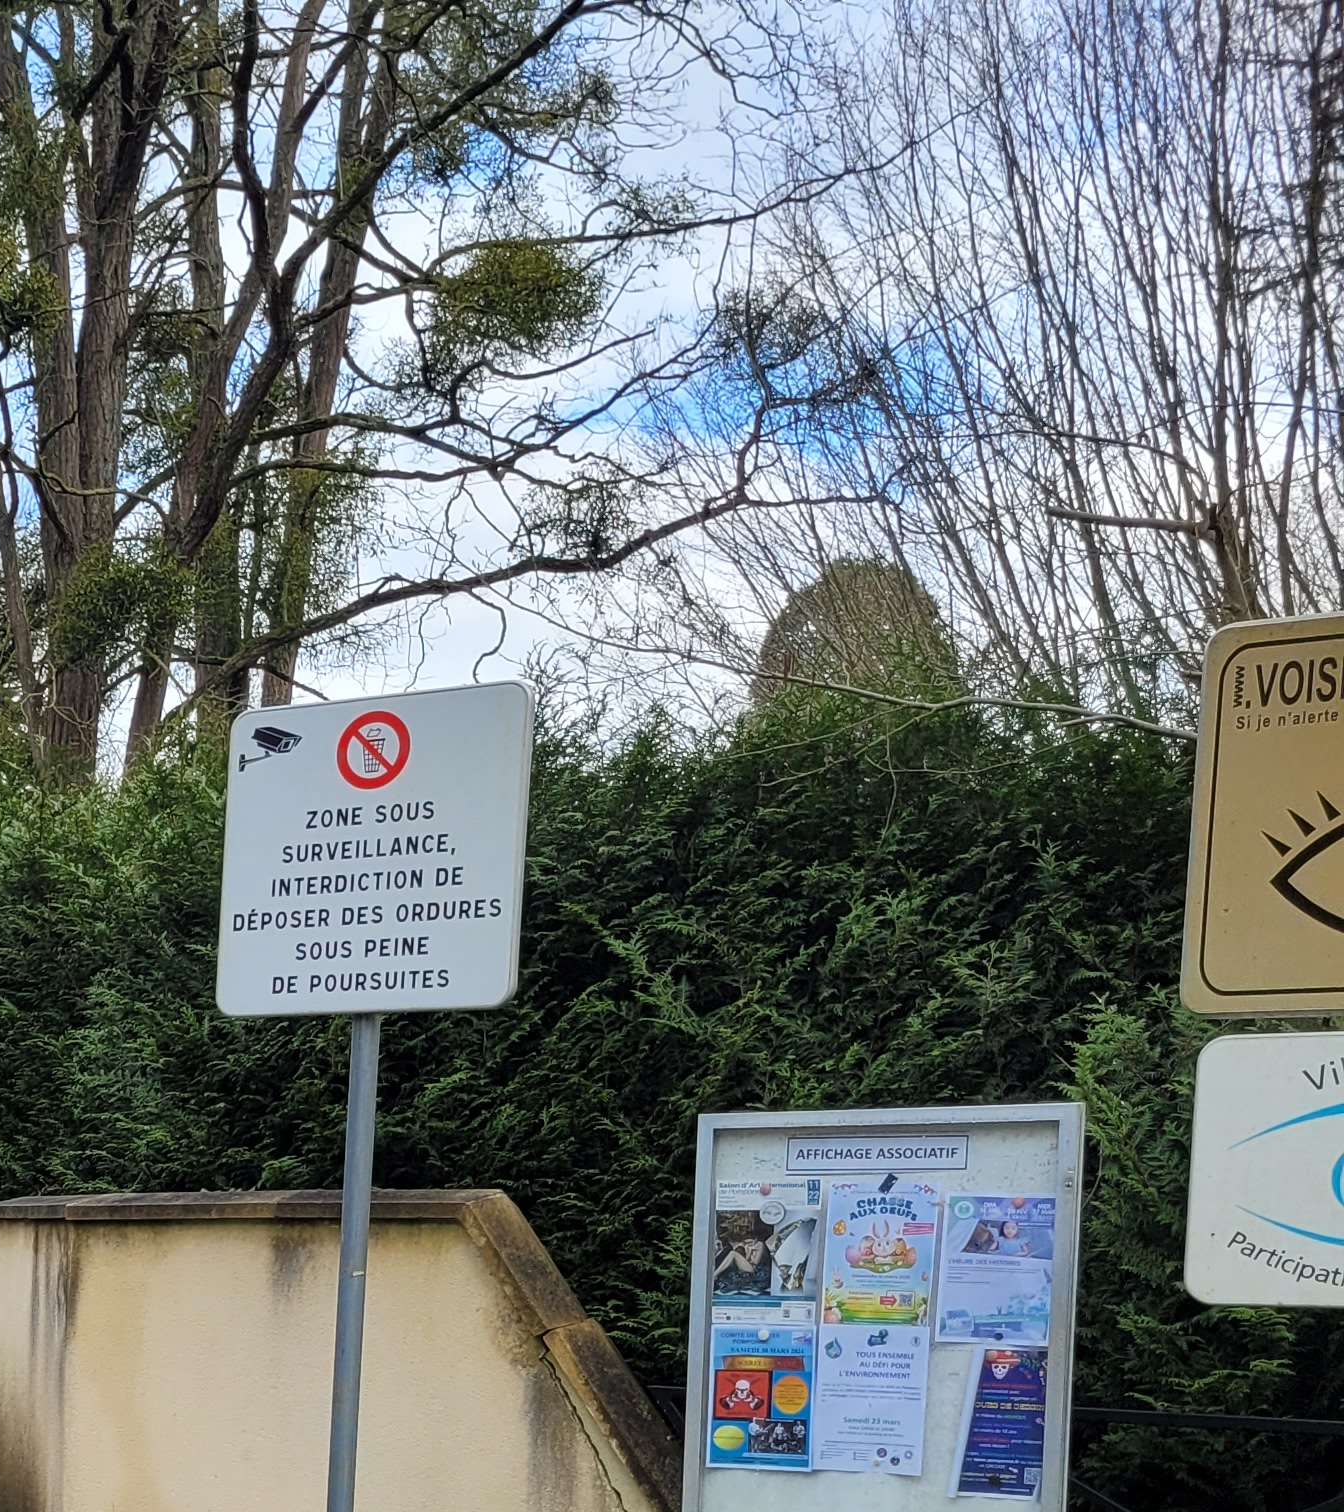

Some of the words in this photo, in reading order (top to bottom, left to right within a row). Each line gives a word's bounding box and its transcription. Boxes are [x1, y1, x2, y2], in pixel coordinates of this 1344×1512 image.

[1235, 715, 1251, 730] Si
[1255, 713, 1271, 733] je
[1277, 709, 1339, 727] n'alerte
[305, 806, 364, 830] ZONE
[374, 801, 435, 824] SOUS
[281, 833, 457, 865] SURVEILLANCE,
[270, 868, 424, 898] INTERDICTION
[434, 866, 465, 887] DE
[232, 908, 330, 933] DÉPOSER
[341, 905, 383, 926] DES
[396, 898, 502, 923] ORDURES
[295, 940, 353, 961] SOUS
[364, 936, 430, 958] PEINE
[272, 975, 298, 995] DE
[309, 968, 450, 993] POURSUITES
[795, 1147, 873, 1160] AFFICHAGE
[875, 1146, 960, 1160] ASSOCIATIF
[808, 1190, 819, 1199] 22
[856, 1196, 914, 1210] CHASSE
[849, 1207, 877, 1221] AUX
[879, 1206, 918, 1222] OEUFS
[878, 1352, 915, 1360] ENSEMBLE
[872, 1360, 889, 1368] DÉFI
[890, 1362, 911, 1370] POUR
[839, 1370, 911, 1380] L'ENVIRONNEMENT
[843, 1416, 870, 1424] Samedi
[871, 1417, 881, 1425] 23
